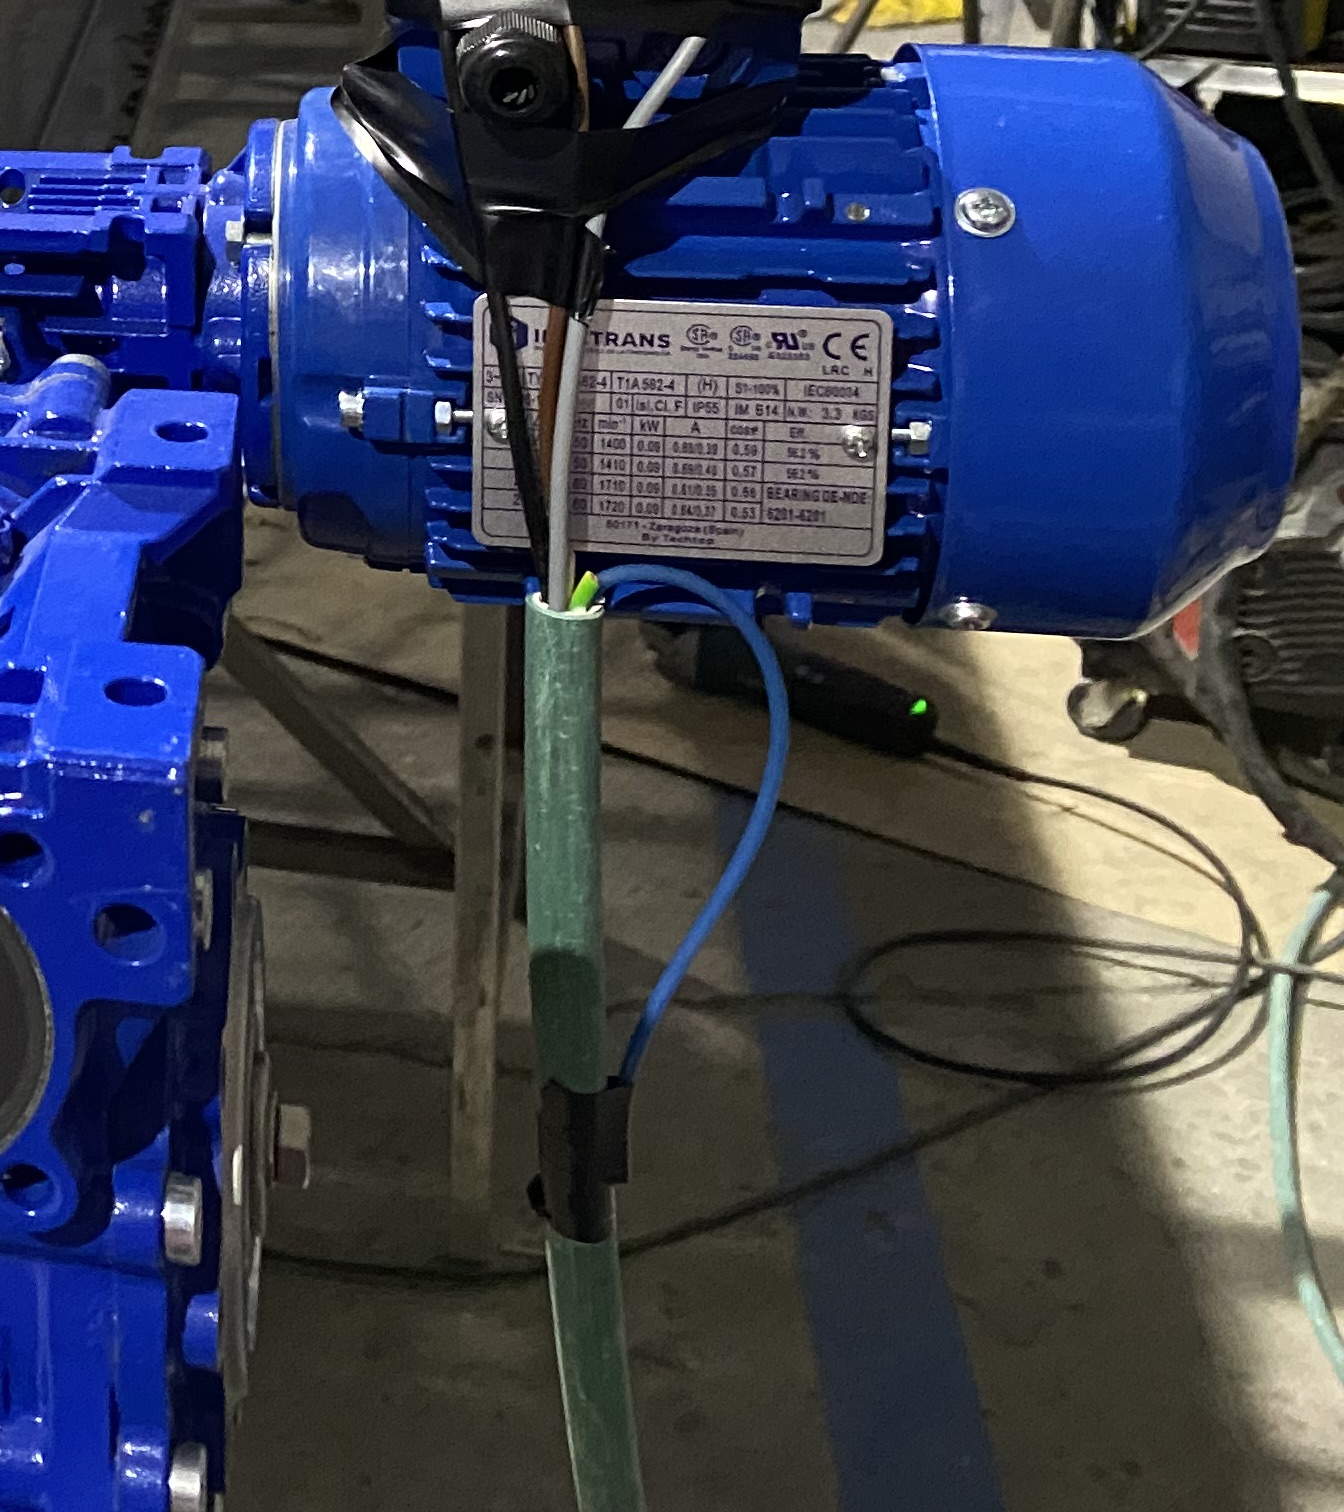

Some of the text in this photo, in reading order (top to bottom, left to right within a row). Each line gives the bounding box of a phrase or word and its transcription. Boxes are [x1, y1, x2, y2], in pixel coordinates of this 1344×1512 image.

[822, 332, 870, 361] CE
[698, 378, 718, 395] (H)
[693, 401, 720, 414] IP55
[639, 419, 660, 432] kW
[691, 419, 701, 434] A
[600, 458, 626, 471] 1410
